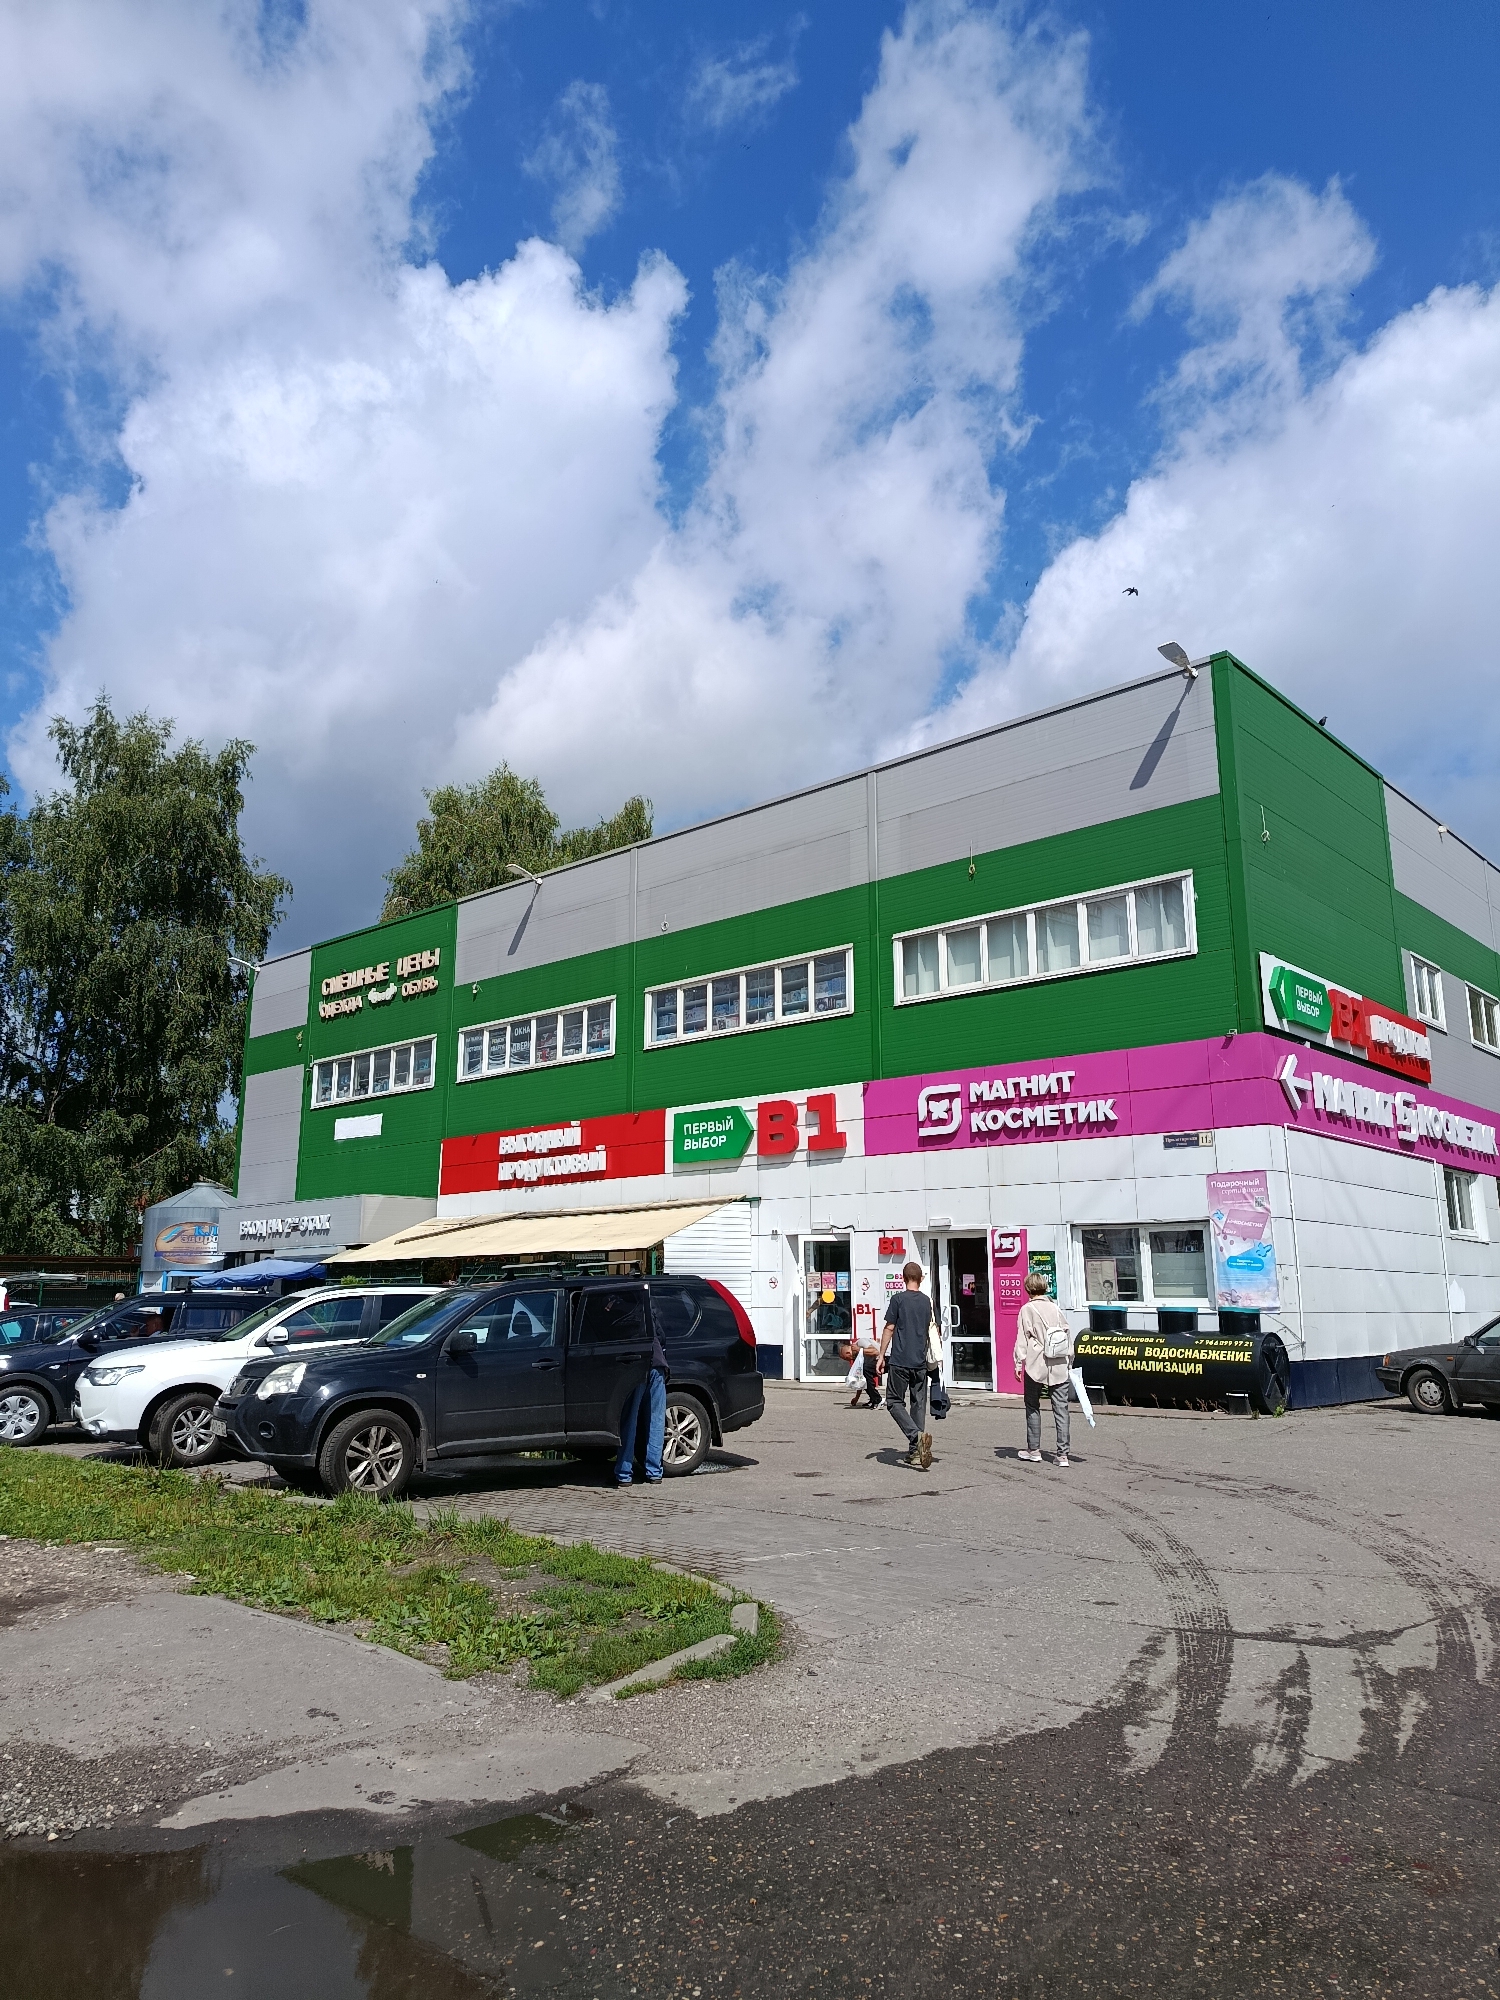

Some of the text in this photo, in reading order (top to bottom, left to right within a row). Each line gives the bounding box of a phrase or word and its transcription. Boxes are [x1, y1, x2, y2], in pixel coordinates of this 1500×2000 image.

[322, 948, 441, 996] СМЕШНЫЕ ЦЕНЫ
[319, 976, 439, 1018] ОДЕЖДА ОБУВЬ
[1295, 984, 1324, 1006] ПЕРВЫЙ
[1297, 1000, 1320, 1018] ВЫБОР
[514, 1025, 531, 1037] ОКНА
[969, 1071, 1076, 1103] МАГНИТ
[971, 1099, 1119, 1133] КОСМЕТИК
[1311, 1072, 1500, 1156] МАГНИТ КОСМЕТИК
[683, 1115, 734, 1136] ПЕРВЫЙ
[499, 1121, 582, 1155] ВЫГОДНЫЙ
[684, 1135, 727, 1151] ВЫБОР
[498, 1145, 607, 1182] ПРОДУКТОВЫЙ
[1211, 1178, 1260, 1188] Подарочный
[193, 1225, 219, 1237] КЛ
[239, 1220, 267, 1237] ВХОД
[267, 1218, 283, 1233] НА
[300, 1213, 331, 1231] ЭТАЖ
[180, 1235, 219, 1245] здоро
[1144, 1346, 1253, 1362] ВОДОСНАБЖЕНИЕ
[1118, 1359, 1203, 1376] КАНАЛИЗАЦИЯ
